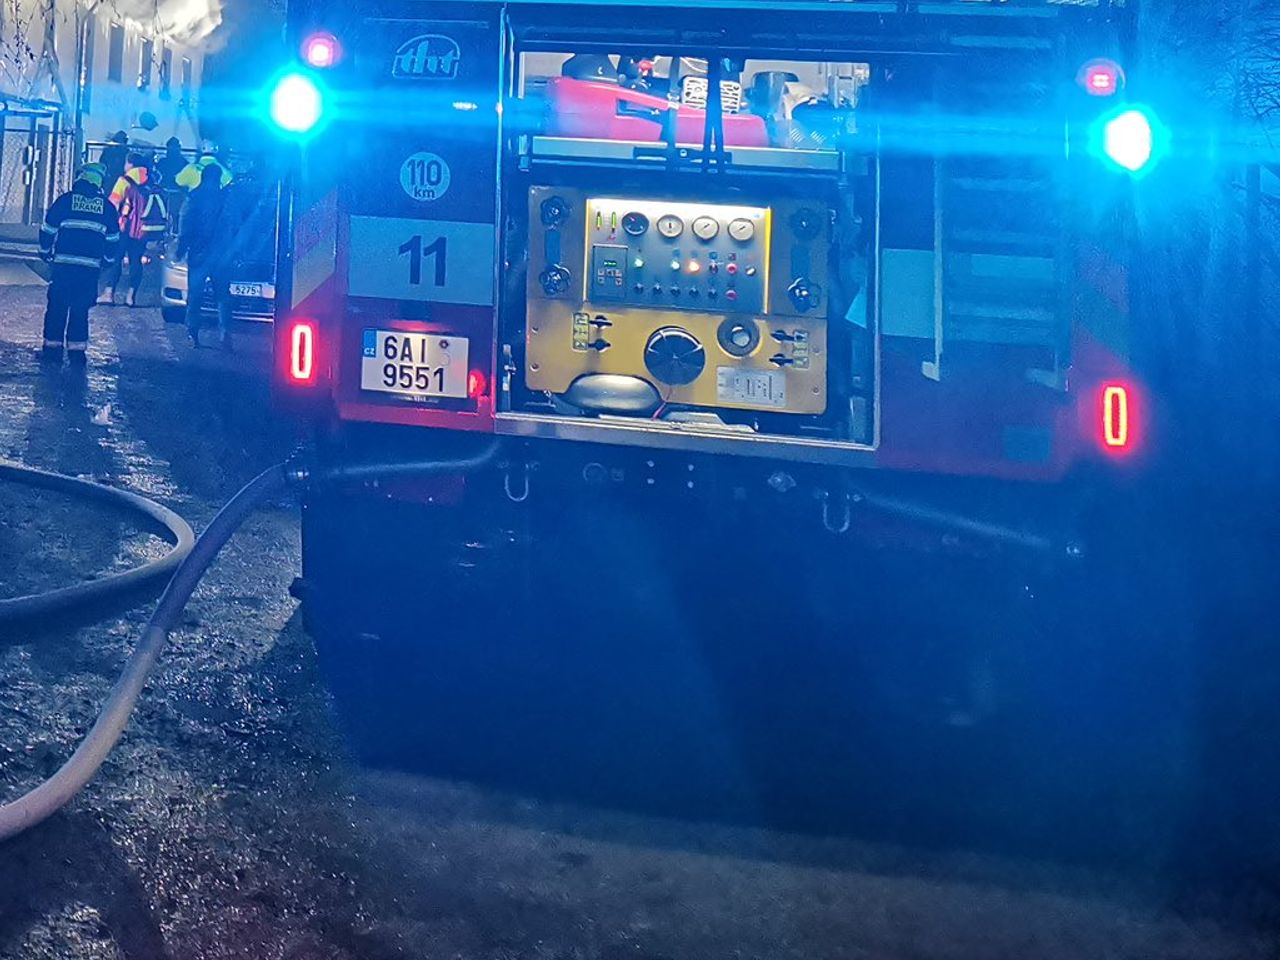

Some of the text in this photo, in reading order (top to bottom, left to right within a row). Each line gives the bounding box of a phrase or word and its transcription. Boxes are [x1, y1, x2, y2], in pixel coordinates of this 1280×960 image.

[406, 159, 442, 186] 110
[413, 186, 436, 199] km
[398, 234, 448, 287] 11
[383, 335, 427, 363] 6AI
[383, 363, 445, 393] 9551
